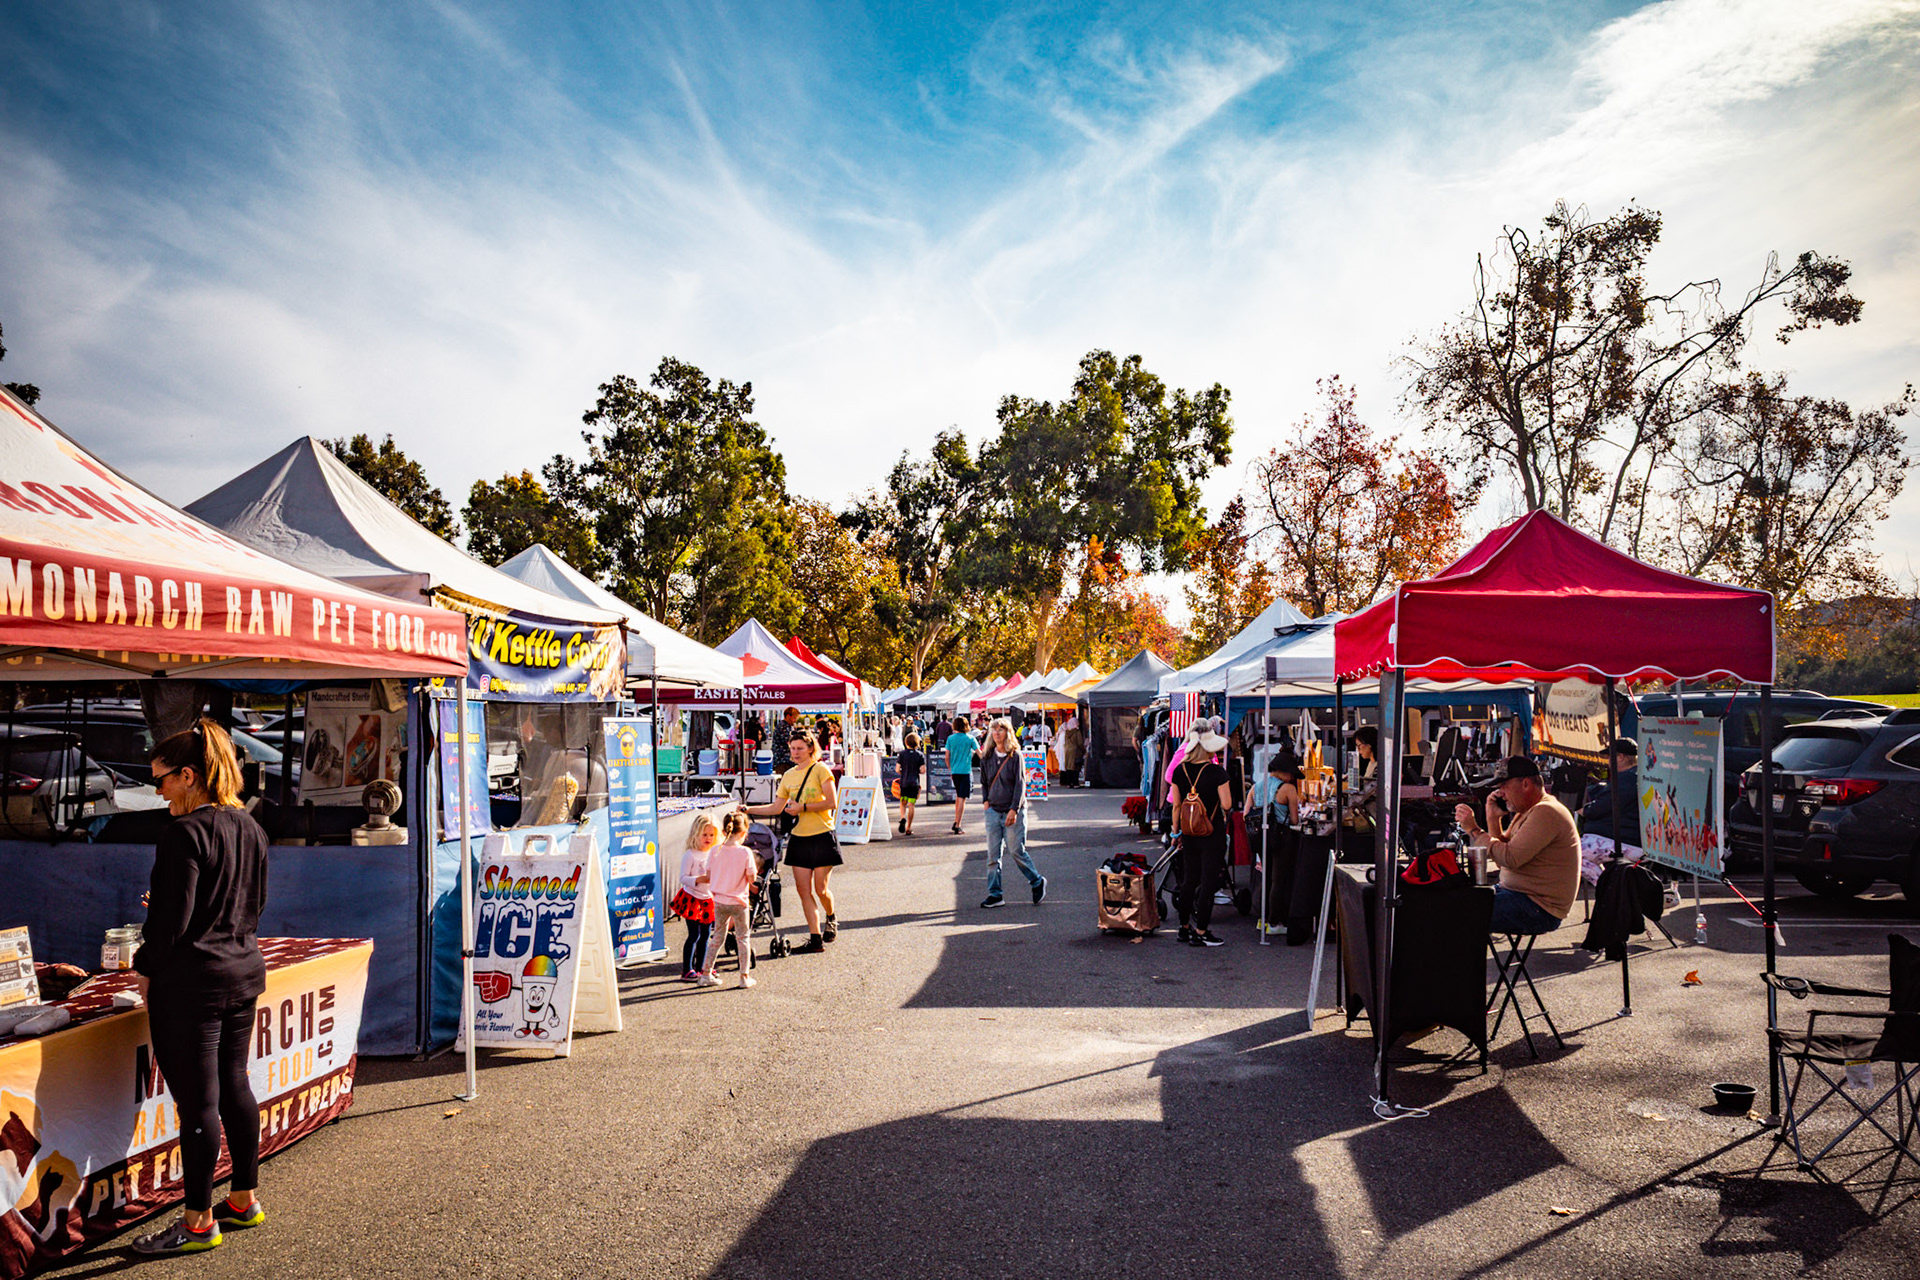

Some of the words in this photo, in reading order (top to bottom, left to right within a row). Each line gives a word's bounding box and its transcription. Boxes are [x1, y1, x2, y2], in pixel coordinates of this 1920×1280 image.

[0, 555, 202, 631] MONARCH
[226, 586, 293, 637] RAW
[313, 597, 356, 645] PET
[488, 621, 561, 668] Kettle
[566, 632, 609, 669] Corn
[312, 691, 350, 701] Handcrafted
[759, 691, 785, 699] TALES
[1547, 710, 1560, 729] DOG
[1561, 712, 1589, 733] TREATS
[480, 864, 582, 901] Shaved
[475, 901, 575, 959] ICE
[476, 1009, 487, 1019] All
[488, 1009, 503, 1021] Your
[267, 1047, 313, 1093] FOOD
[258, 1098, 293, 1143] PET
[88, 1162, 143, 1218] PET
